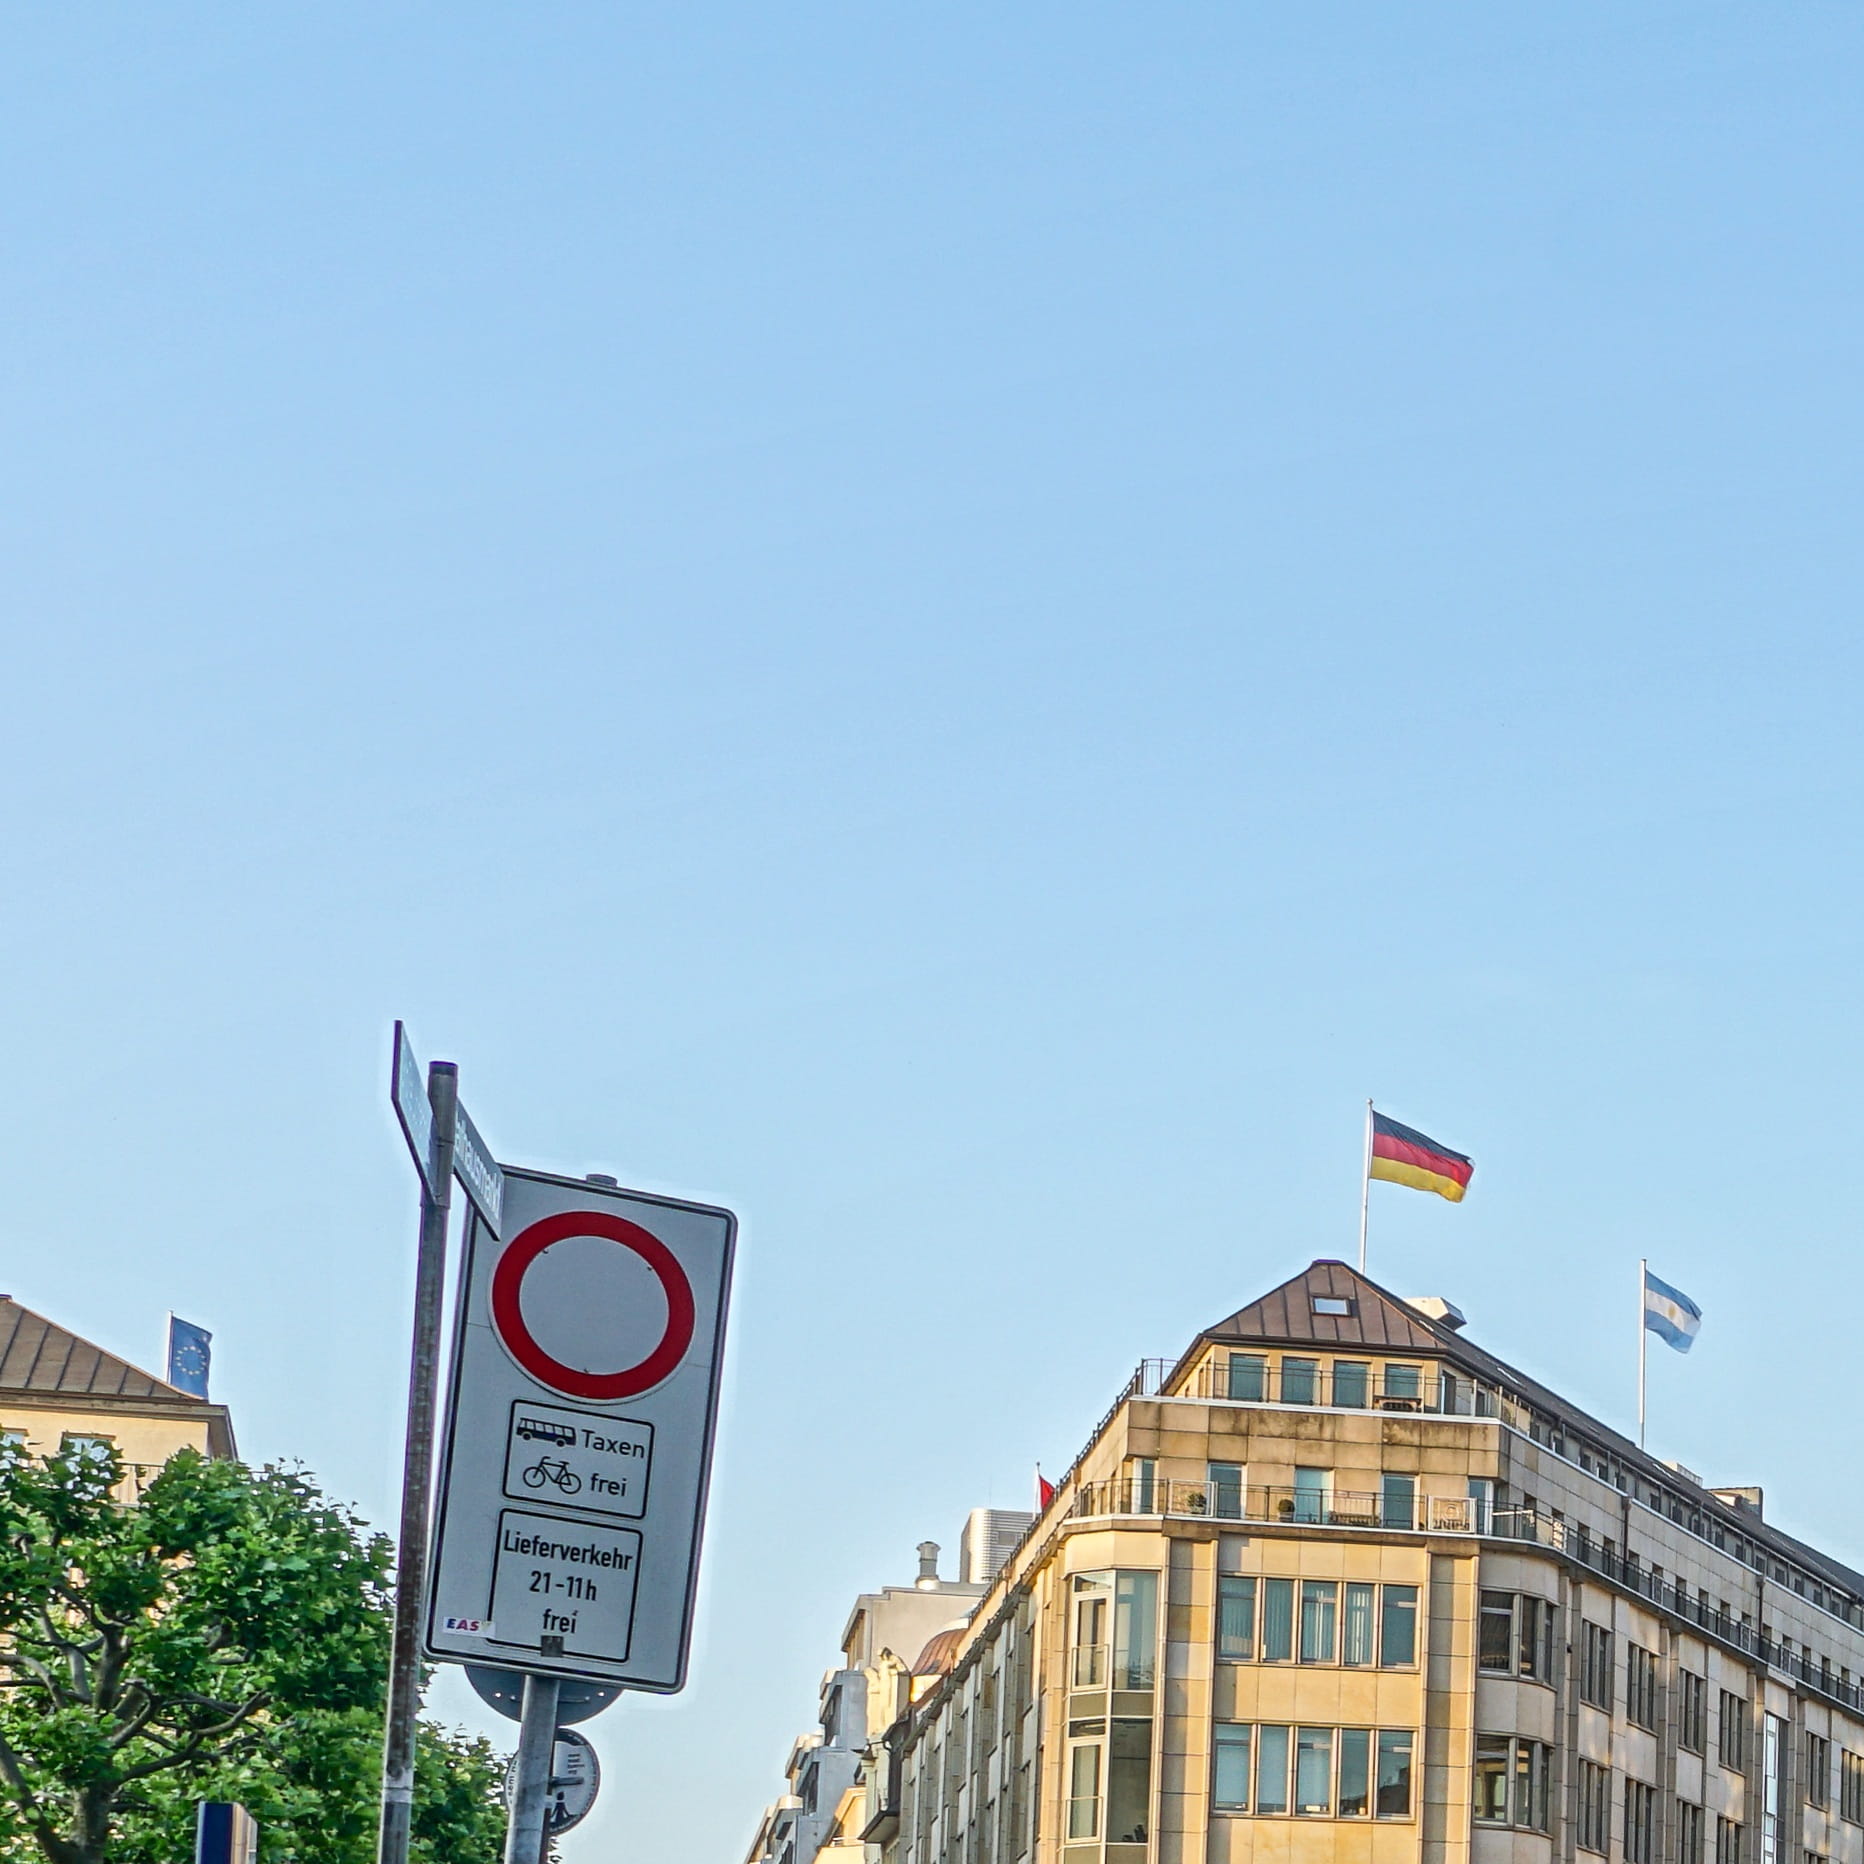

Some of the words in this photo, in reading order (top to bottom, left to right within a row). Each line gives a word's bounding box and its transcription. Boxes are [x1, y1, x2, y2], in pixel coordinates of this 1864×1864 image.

[582, 1429, 645, 1459] Taxen
[591, 1473, 628, 1497] frei
[503, 1529, 633, 1570] Lieferverkehr
[542, 1608, 579, 1634] frei
